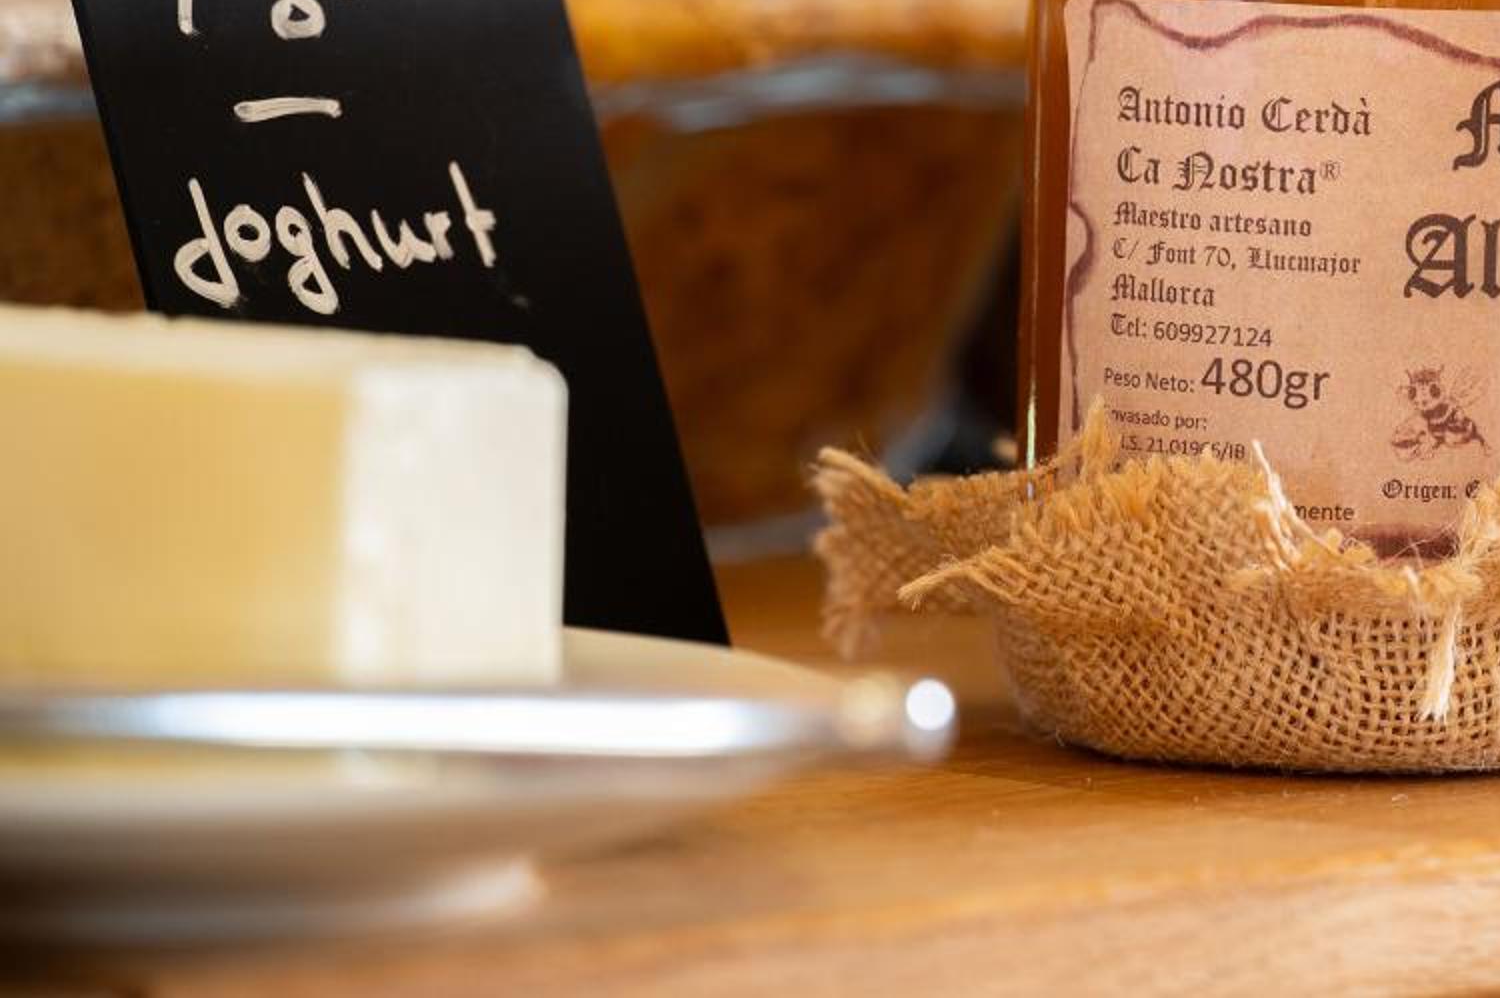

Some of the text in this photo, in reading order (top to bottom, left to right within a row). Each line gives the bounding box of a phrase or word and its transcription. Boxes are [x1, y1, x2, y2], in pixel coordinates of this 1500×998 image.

[1118, 86, 1371, 135] Antonio Cerdà
[1117, 146, 1160, 185] Ca
[1113, 202, 1312, 238] Maestro artesano
[1145, 241, 1197, 266] Font
[1247, 246, 1361, 278] Llucmajor
[1111, 273, 1216, 307] Mallorca
[1110, 313, 1273, 348] Tel: 609927124
[1104, 357, 1331, 410] Peso Neto: 480gr
[1175, 415, 1208, 432] por:
[1382, 479, 1457, 502] Origen:
